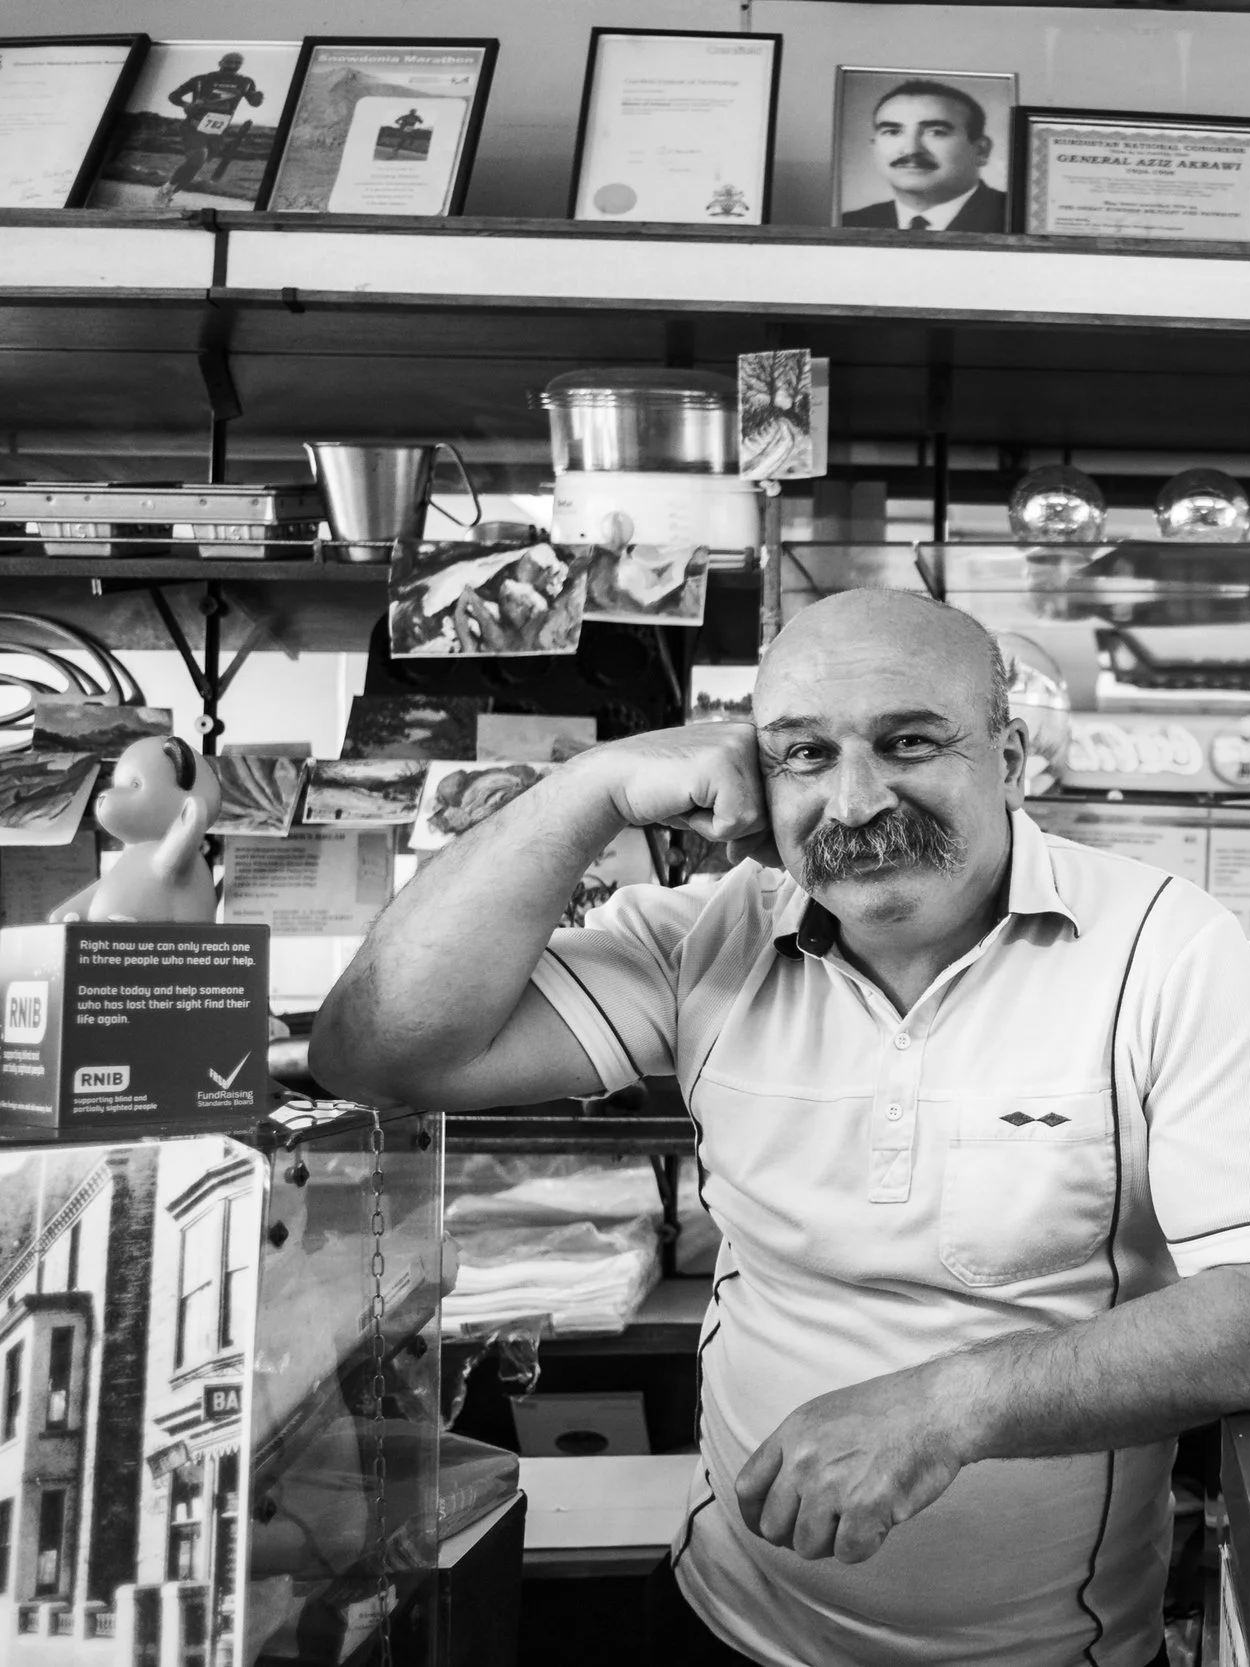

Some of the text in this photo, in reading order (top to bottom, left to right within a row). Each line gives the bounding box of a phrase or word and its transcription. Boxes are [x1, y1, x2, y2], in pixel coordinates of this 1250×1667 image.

[318, 55, 475, 64] Snowdonia Marathon
[1056, 154, 1242, 171] GENERAL AZIZ AKRAWI
[80, 940, 251, 953] Right now we can only reach one
[79, 955, 257, 967] in three people who need our help.
[78, 986, 245, 997] Donate today and help someone
[77, 999, 251, 1011] who has lost their sight find their
[10, 997, 41, 1028] RNIB
[77, 1014, 131, 1026] life again.
[81, 1072, 123, 1087] RNIB
[73, 1096, 113, 1105] supporting
[134, 1094, 148, 1102] and
[198, 1090, 254, 1100] FundRaising
[73, 1103, 158, 1114] partially sighted people
[197, 1100, 232, 1108] Standards
